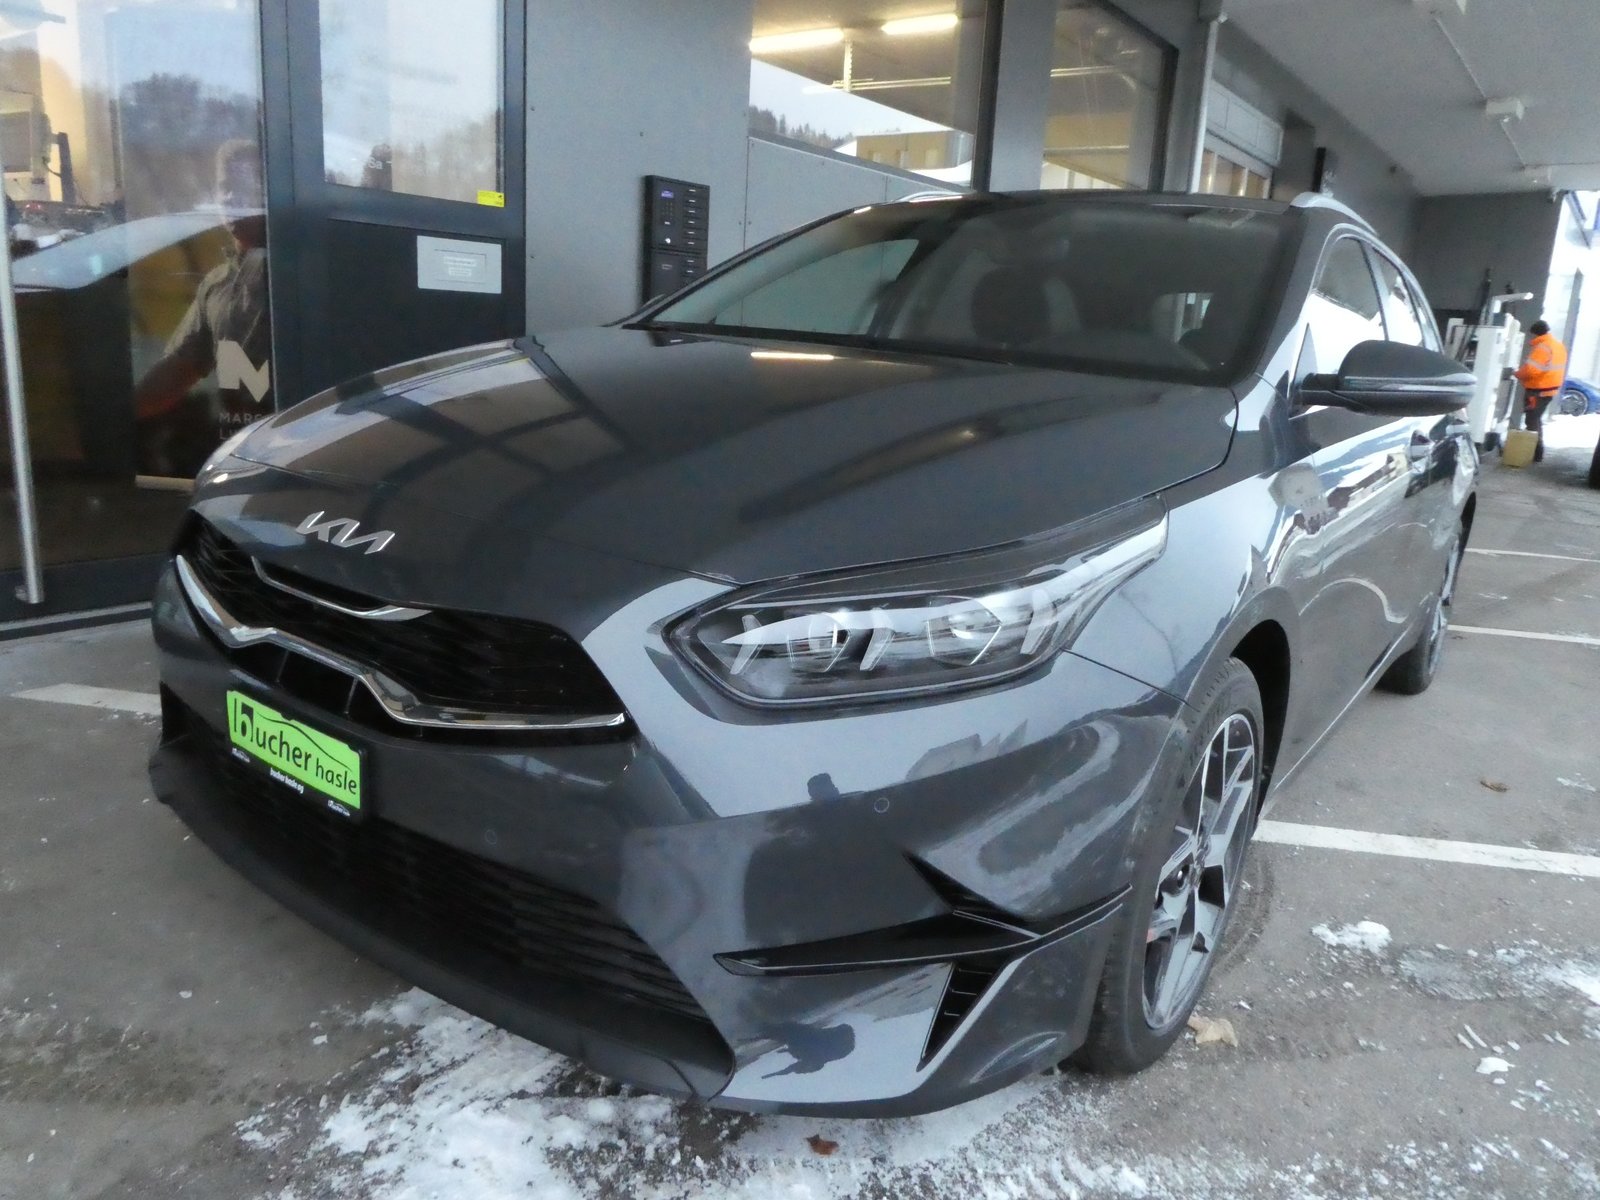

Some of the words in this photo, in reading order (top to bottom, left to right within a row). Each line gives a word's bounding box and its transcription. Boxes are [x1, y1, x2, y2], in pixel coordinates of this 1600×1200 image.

[295, 510, 396, 555] KIA
[233, 697, 312, 771] bucher
[315, 758, 358, 796] hasle
